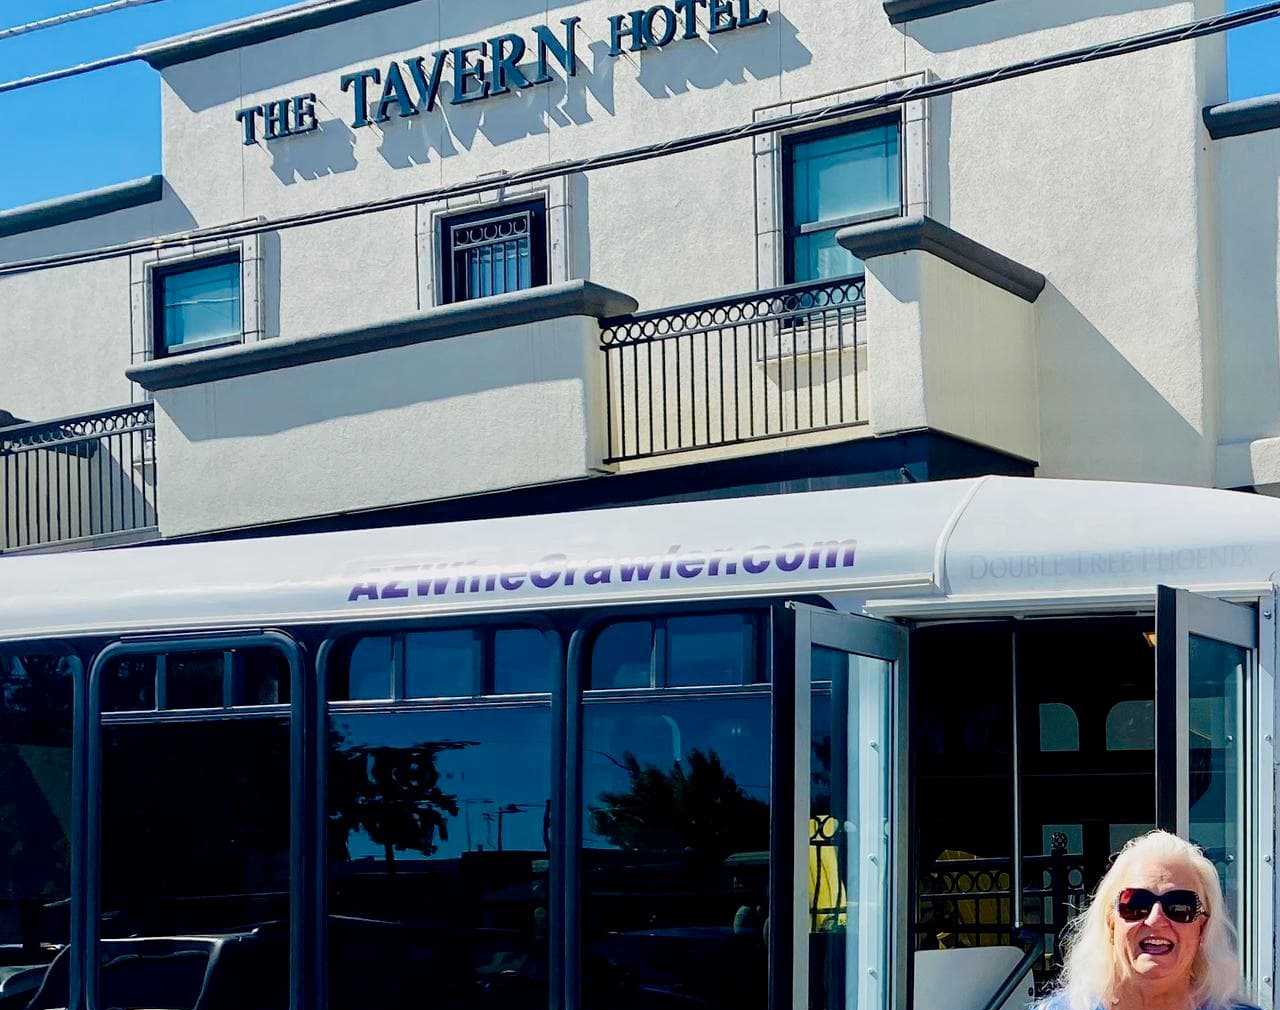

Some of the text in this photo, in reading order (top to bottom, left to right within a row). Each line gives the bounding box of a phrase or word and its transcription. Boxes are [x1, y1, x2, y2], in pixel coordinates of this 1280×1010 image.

[235, 0, 769, 146] THE TAVERN HOTEL
